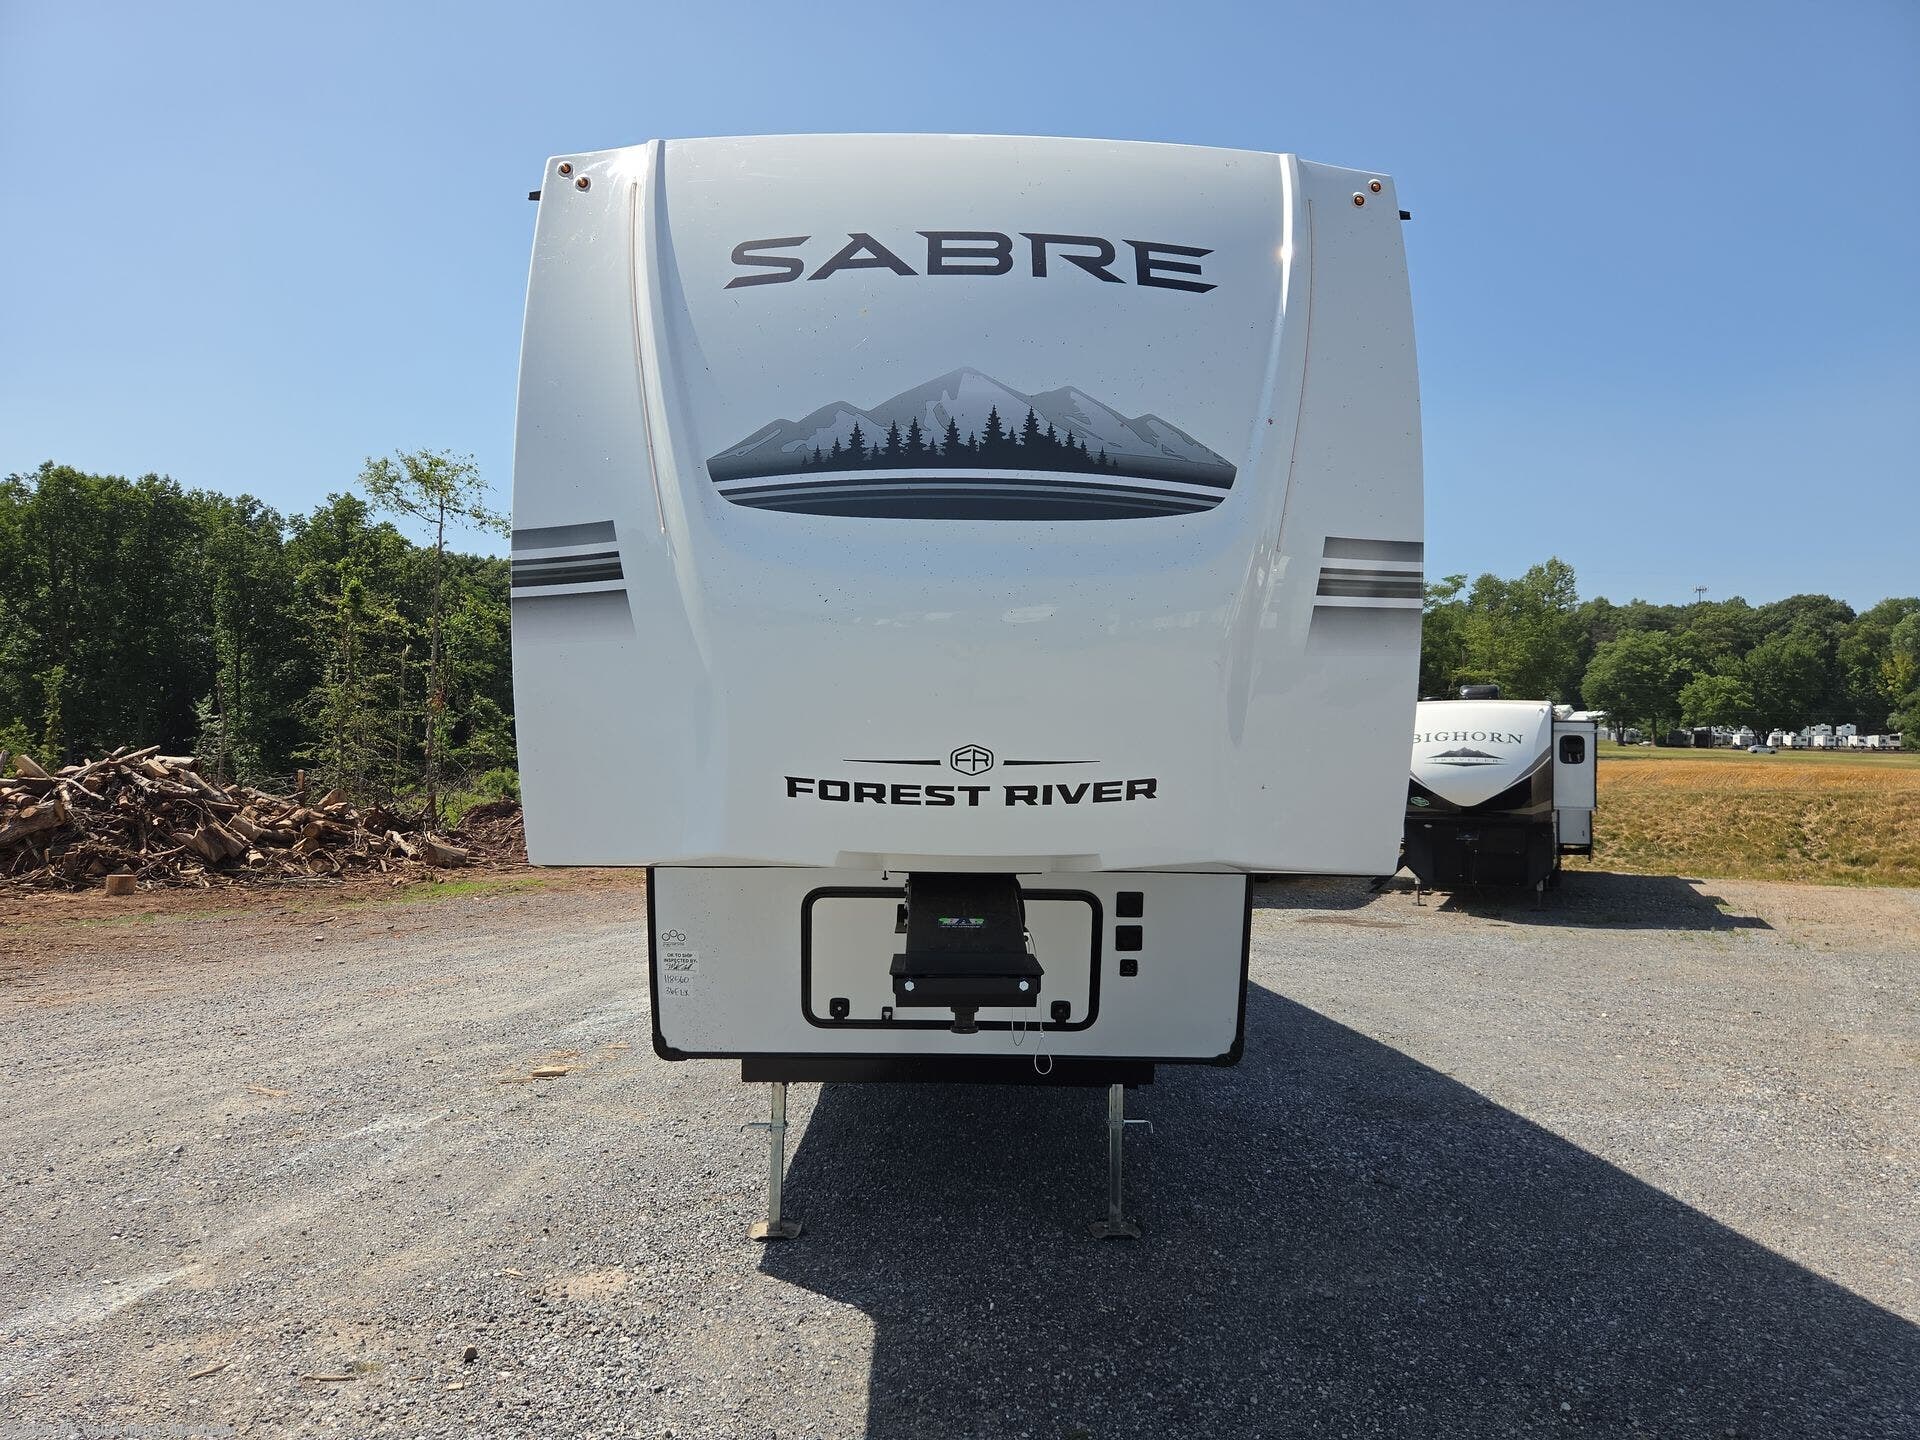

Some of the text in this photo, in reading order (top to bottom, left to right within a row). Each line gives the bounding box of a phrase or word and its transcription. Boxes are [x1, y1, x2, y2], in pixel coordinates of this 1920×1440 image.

[723, 231, 1219, 293] SABRE
[1413, 731, 1524, 745] BIGHORN
[784, 775, 1158, 807] FOREST RIVER
